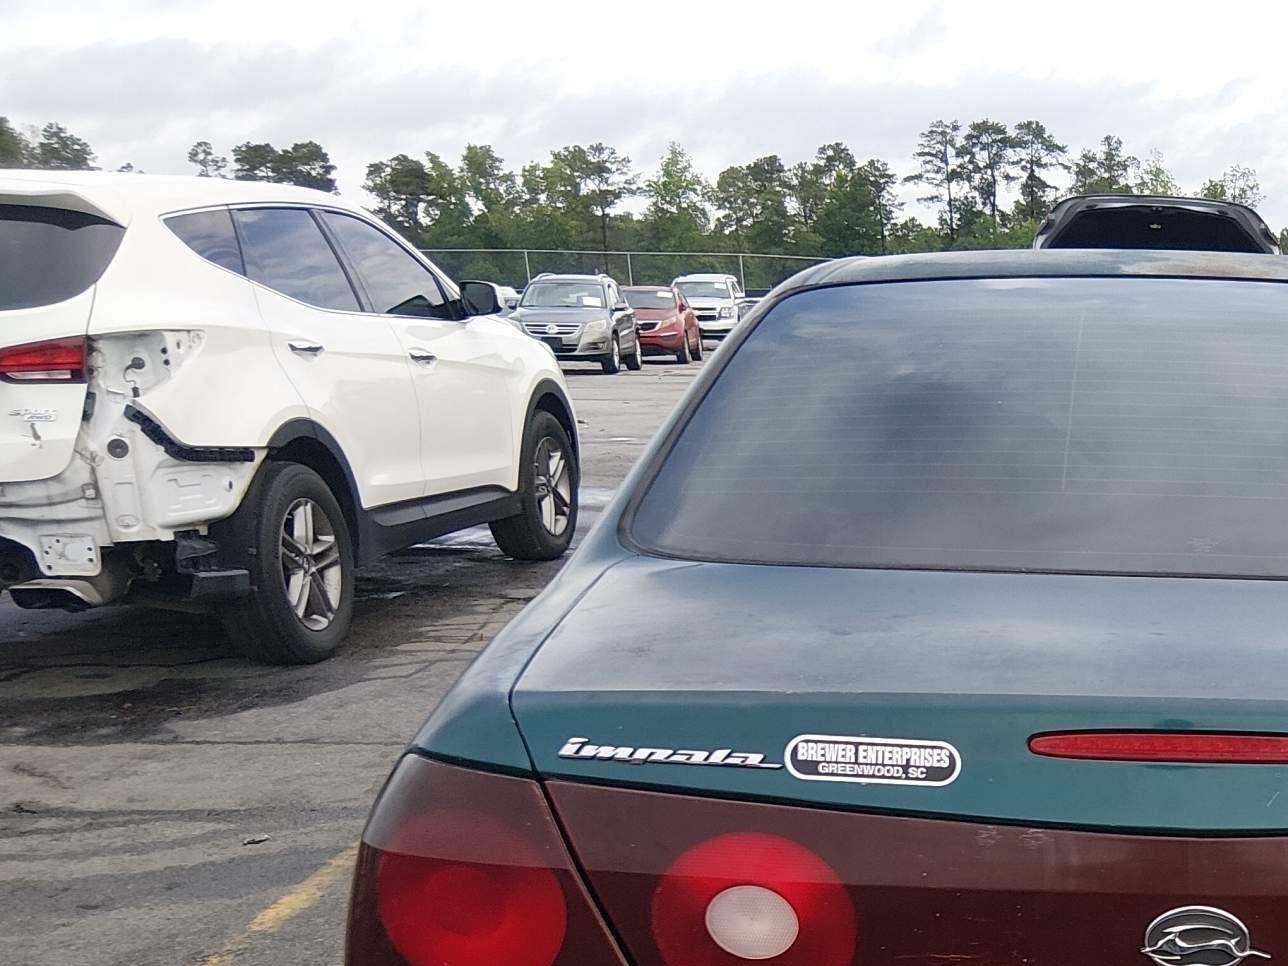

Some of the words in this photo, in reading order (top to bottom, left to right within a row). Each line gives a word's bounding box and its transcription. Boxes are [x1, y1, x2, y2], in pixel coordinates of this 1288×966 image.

[797, 742, 855, 763] BREWER
[858, 745, 950, 768] ENTERPRISES
[817, 762, 904, 779] GREENWOOD,
[907, 767, 928, 778] SC
